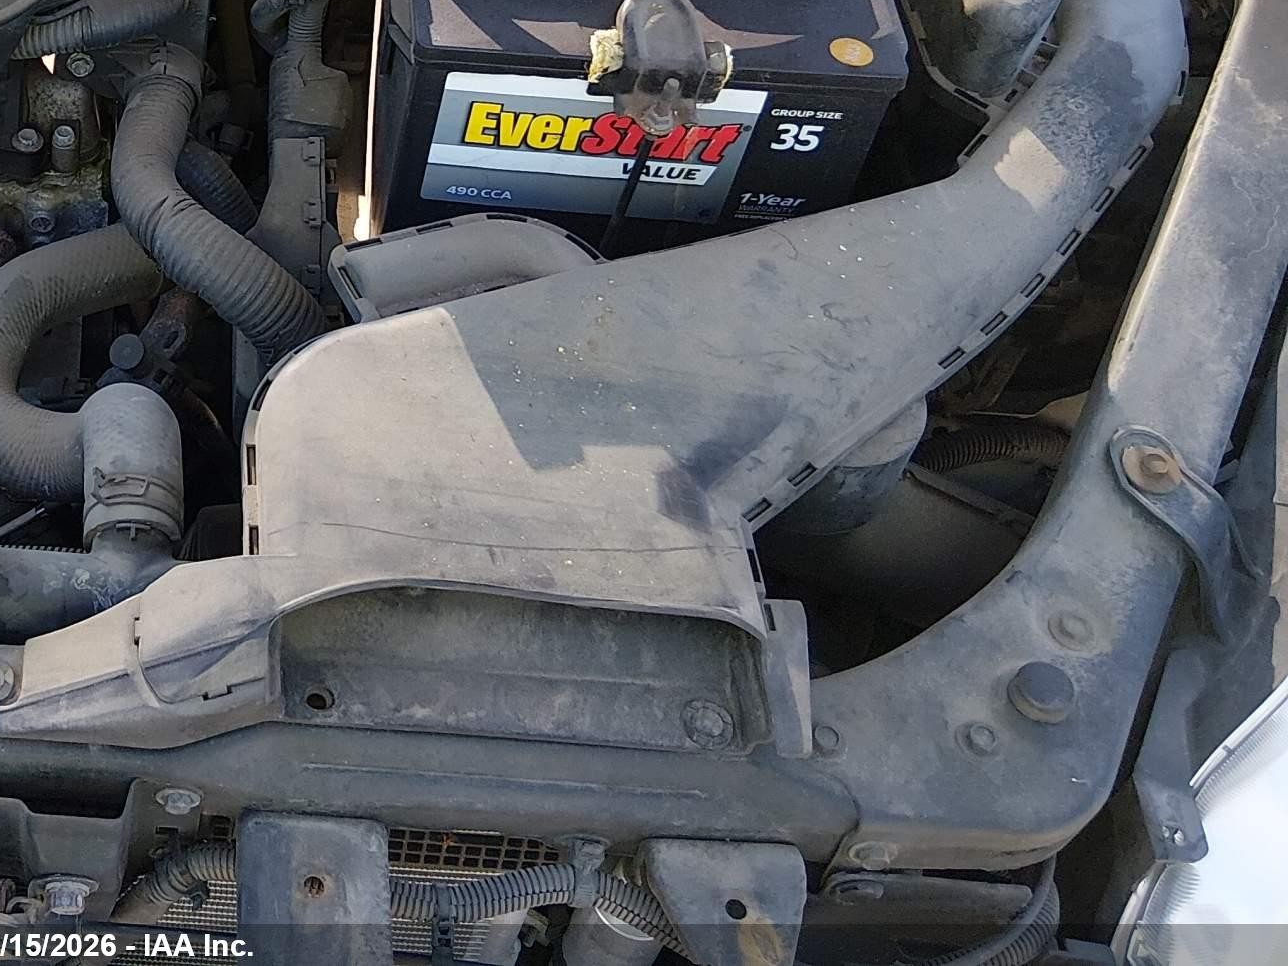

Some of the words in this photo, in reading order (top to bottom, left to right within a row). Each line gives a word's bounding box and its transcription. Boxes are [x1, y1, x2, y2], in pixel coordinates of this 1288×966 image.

[770, 108, 815, 118] GROUP
[815, 111, 844, 120] SIZE
[462, 100, 743, 164] EverStart
[770, 123, 825, 152] 35
[621, 162, 701, 181] VALUE
[446, 185, 478, 197] 490
[480, 188, 513, 201] CCA
[740, 192, 807, 207] 1-Year
